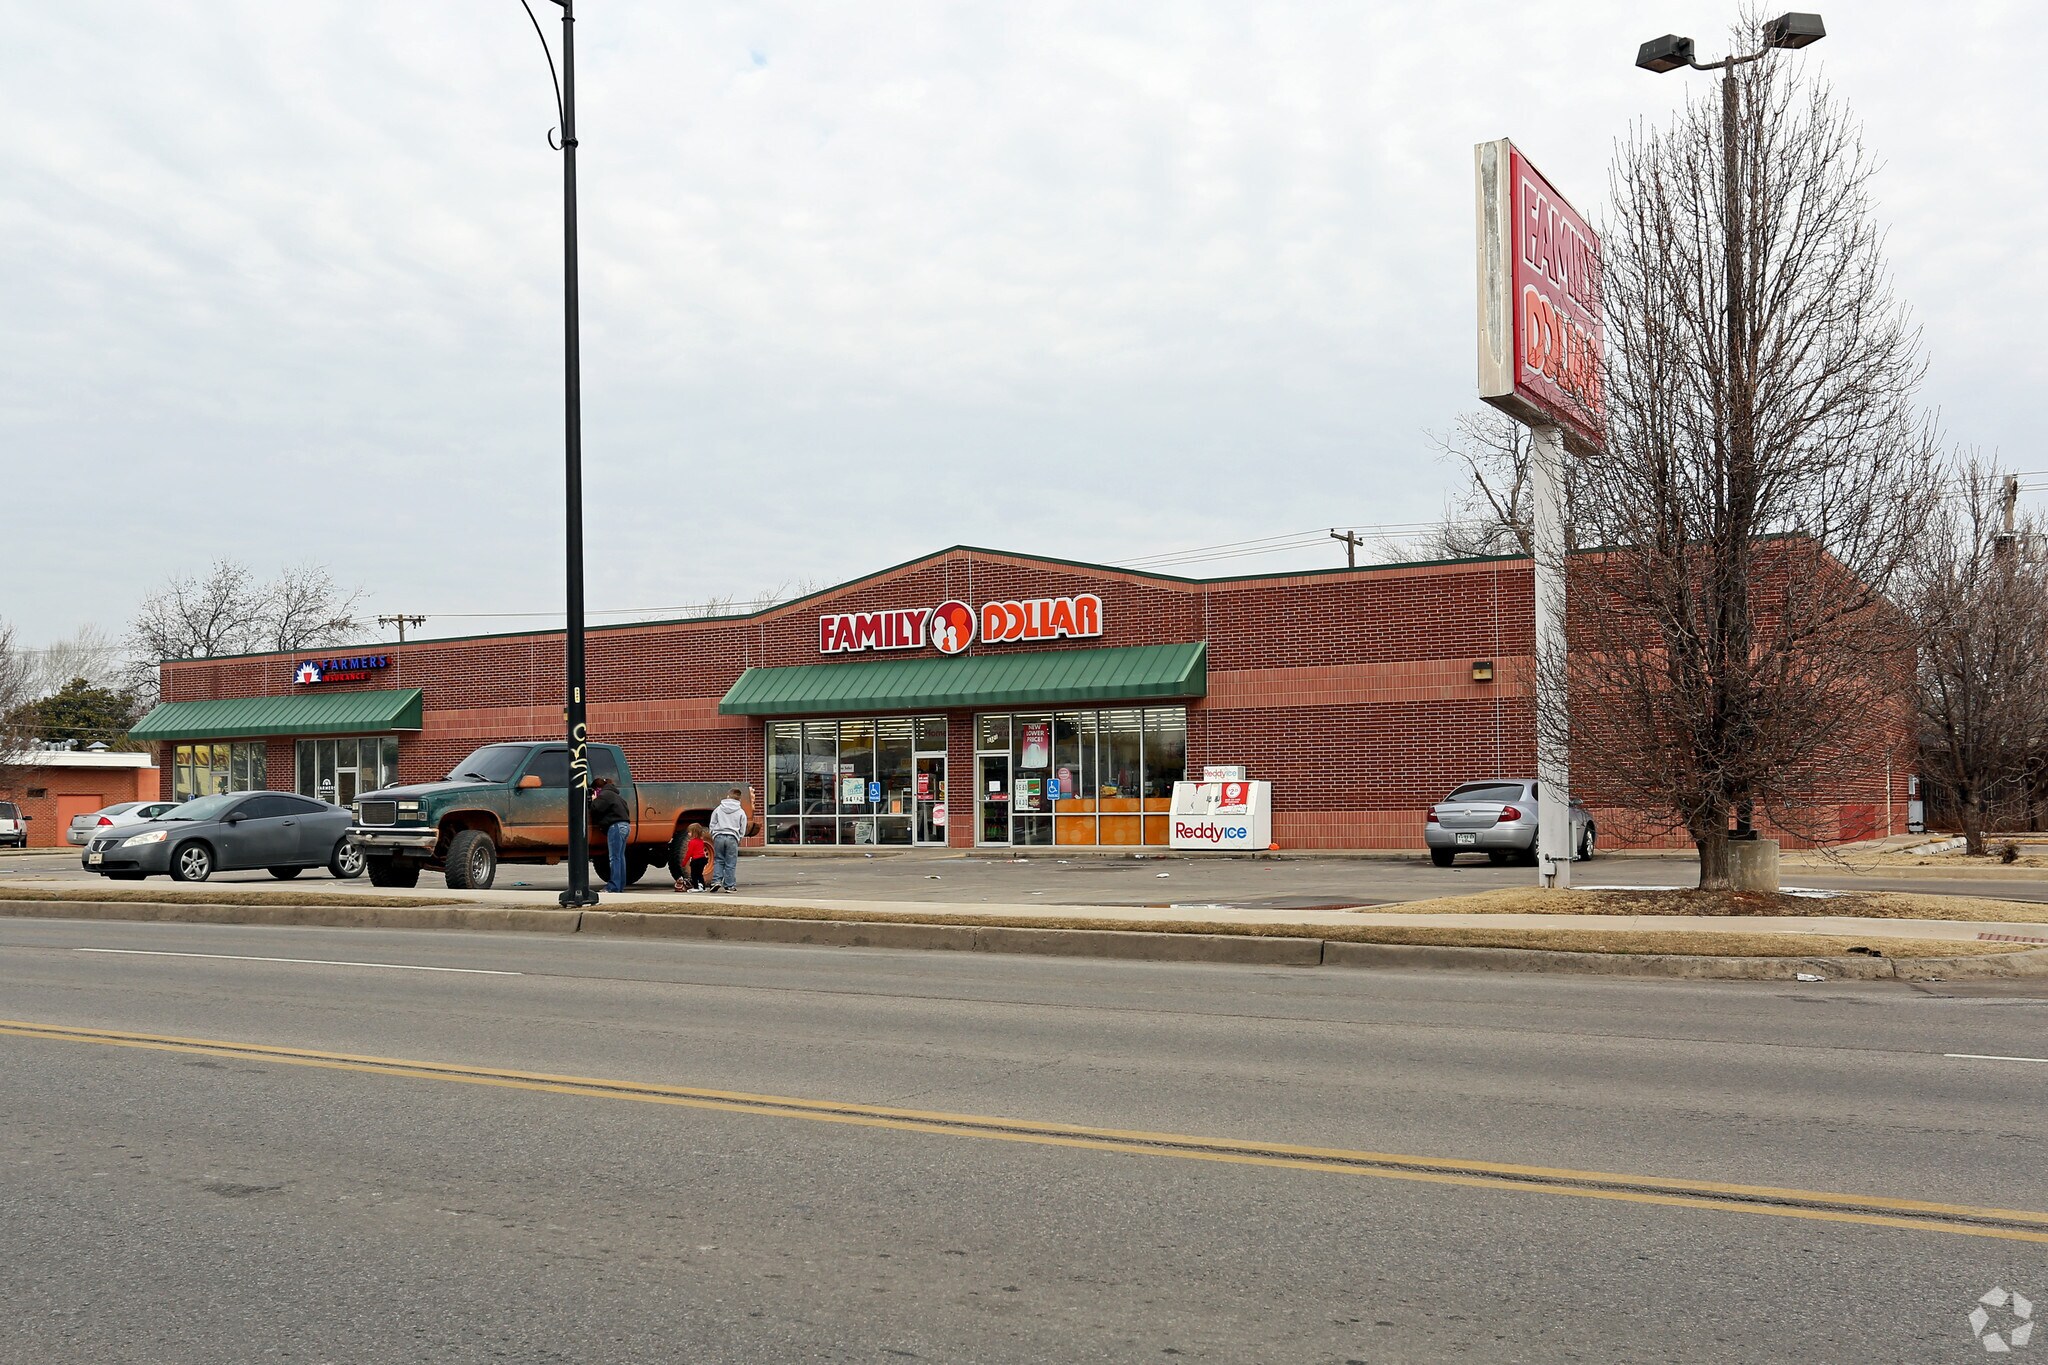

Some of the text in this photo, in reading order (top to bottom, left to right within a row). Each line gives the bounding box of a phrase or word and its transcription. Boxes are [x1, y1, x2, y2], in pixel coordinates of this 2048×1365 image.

[820, 596, 1100, 652] FAMILY DOLLAR
[322, 655, 386, 671] FARMERS
[322, 673, 366, 682] INSURANCE
